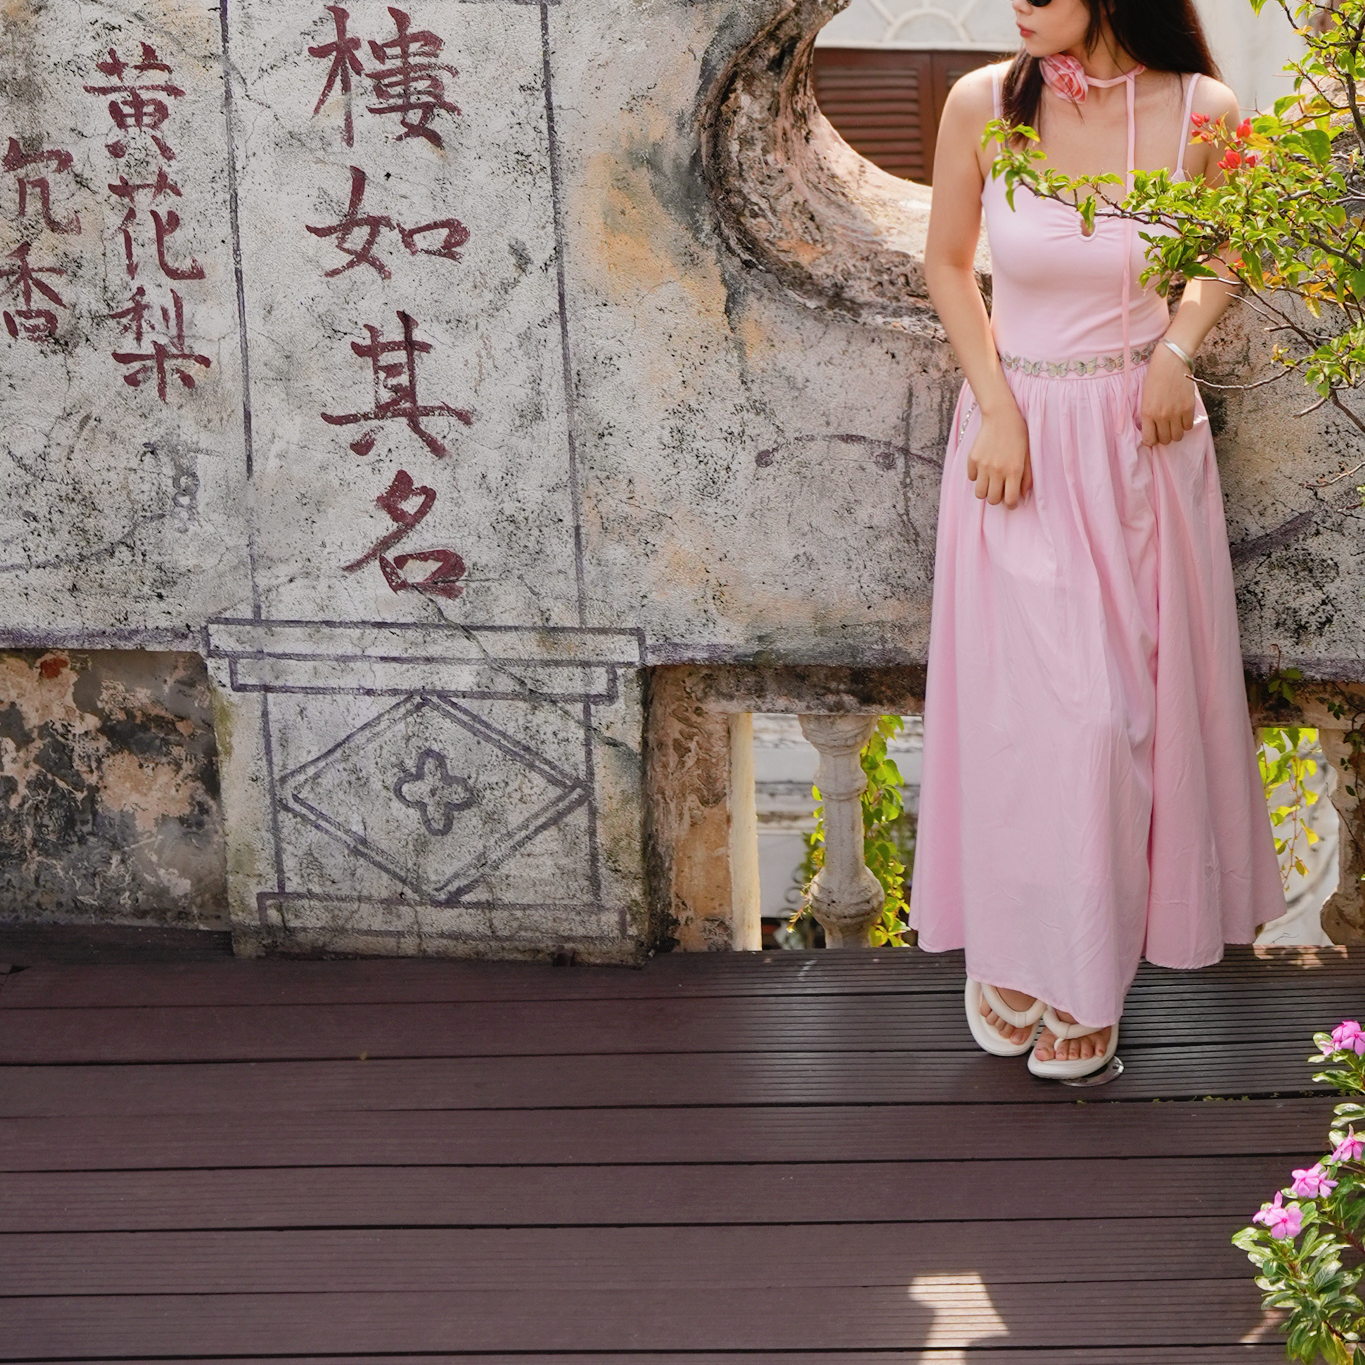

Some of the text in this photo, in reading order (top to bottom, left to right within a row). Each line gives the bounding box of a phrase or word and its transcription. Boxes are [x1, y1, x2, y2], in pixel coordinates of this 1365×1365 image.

[83, 41, 212, 402] 黄花梨
[306, 5, 476, 600] 樓如其名
